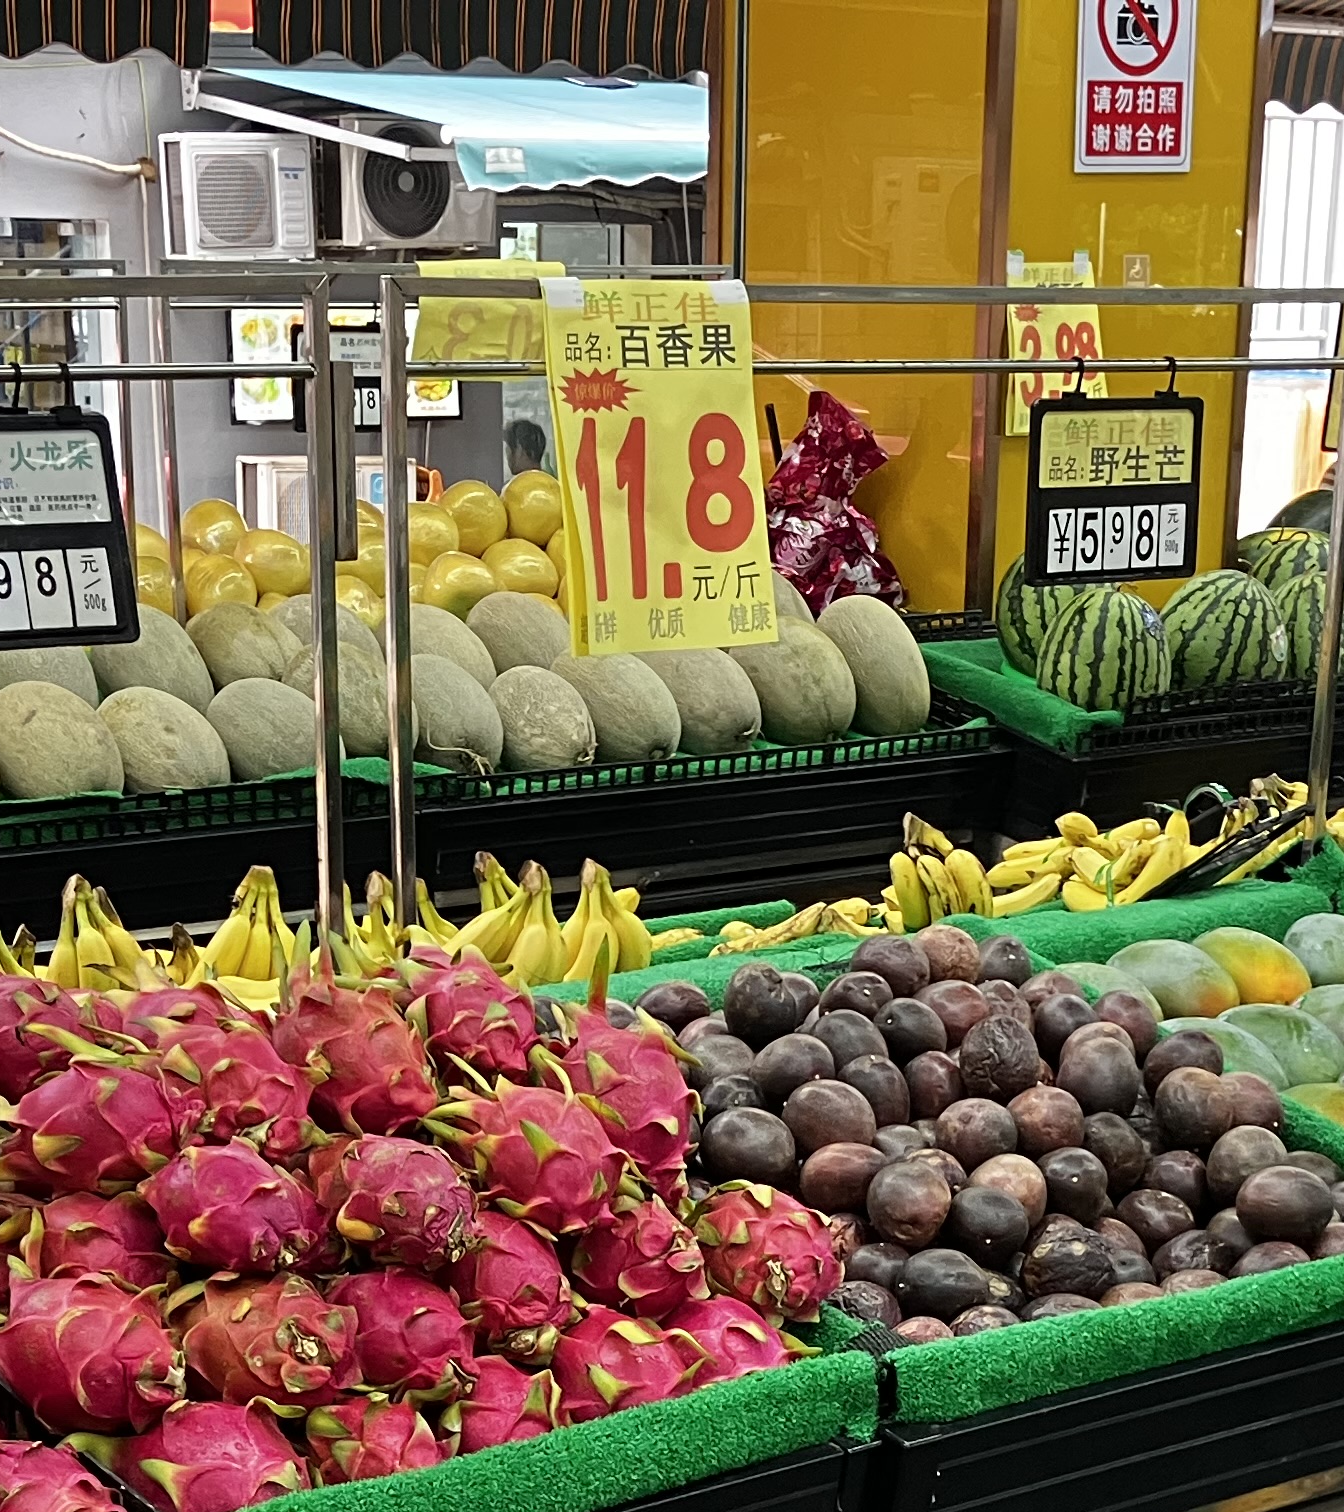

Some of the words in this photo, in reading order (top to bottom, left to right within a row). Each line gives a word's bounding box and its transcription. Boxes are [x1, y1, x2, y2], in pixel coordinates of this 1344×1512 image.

[1093, 85, 1176, 114] 请勿拍照
[1092, 123, 1175, 152] 谢谢合作
[615, 323, 736, 368] 百香果
[9, 440, 93, 472] 火龙果
[1088, 445, 1185, 485] 野生芒
[576, 412, 754, 602] 11.8
[1052, 509, 1154, 564] ¥5.98
[693, 561, 760, 601] 元/斤
[647, 607, 686, 640] 优质
[728, 602, 772, 635] 健康
